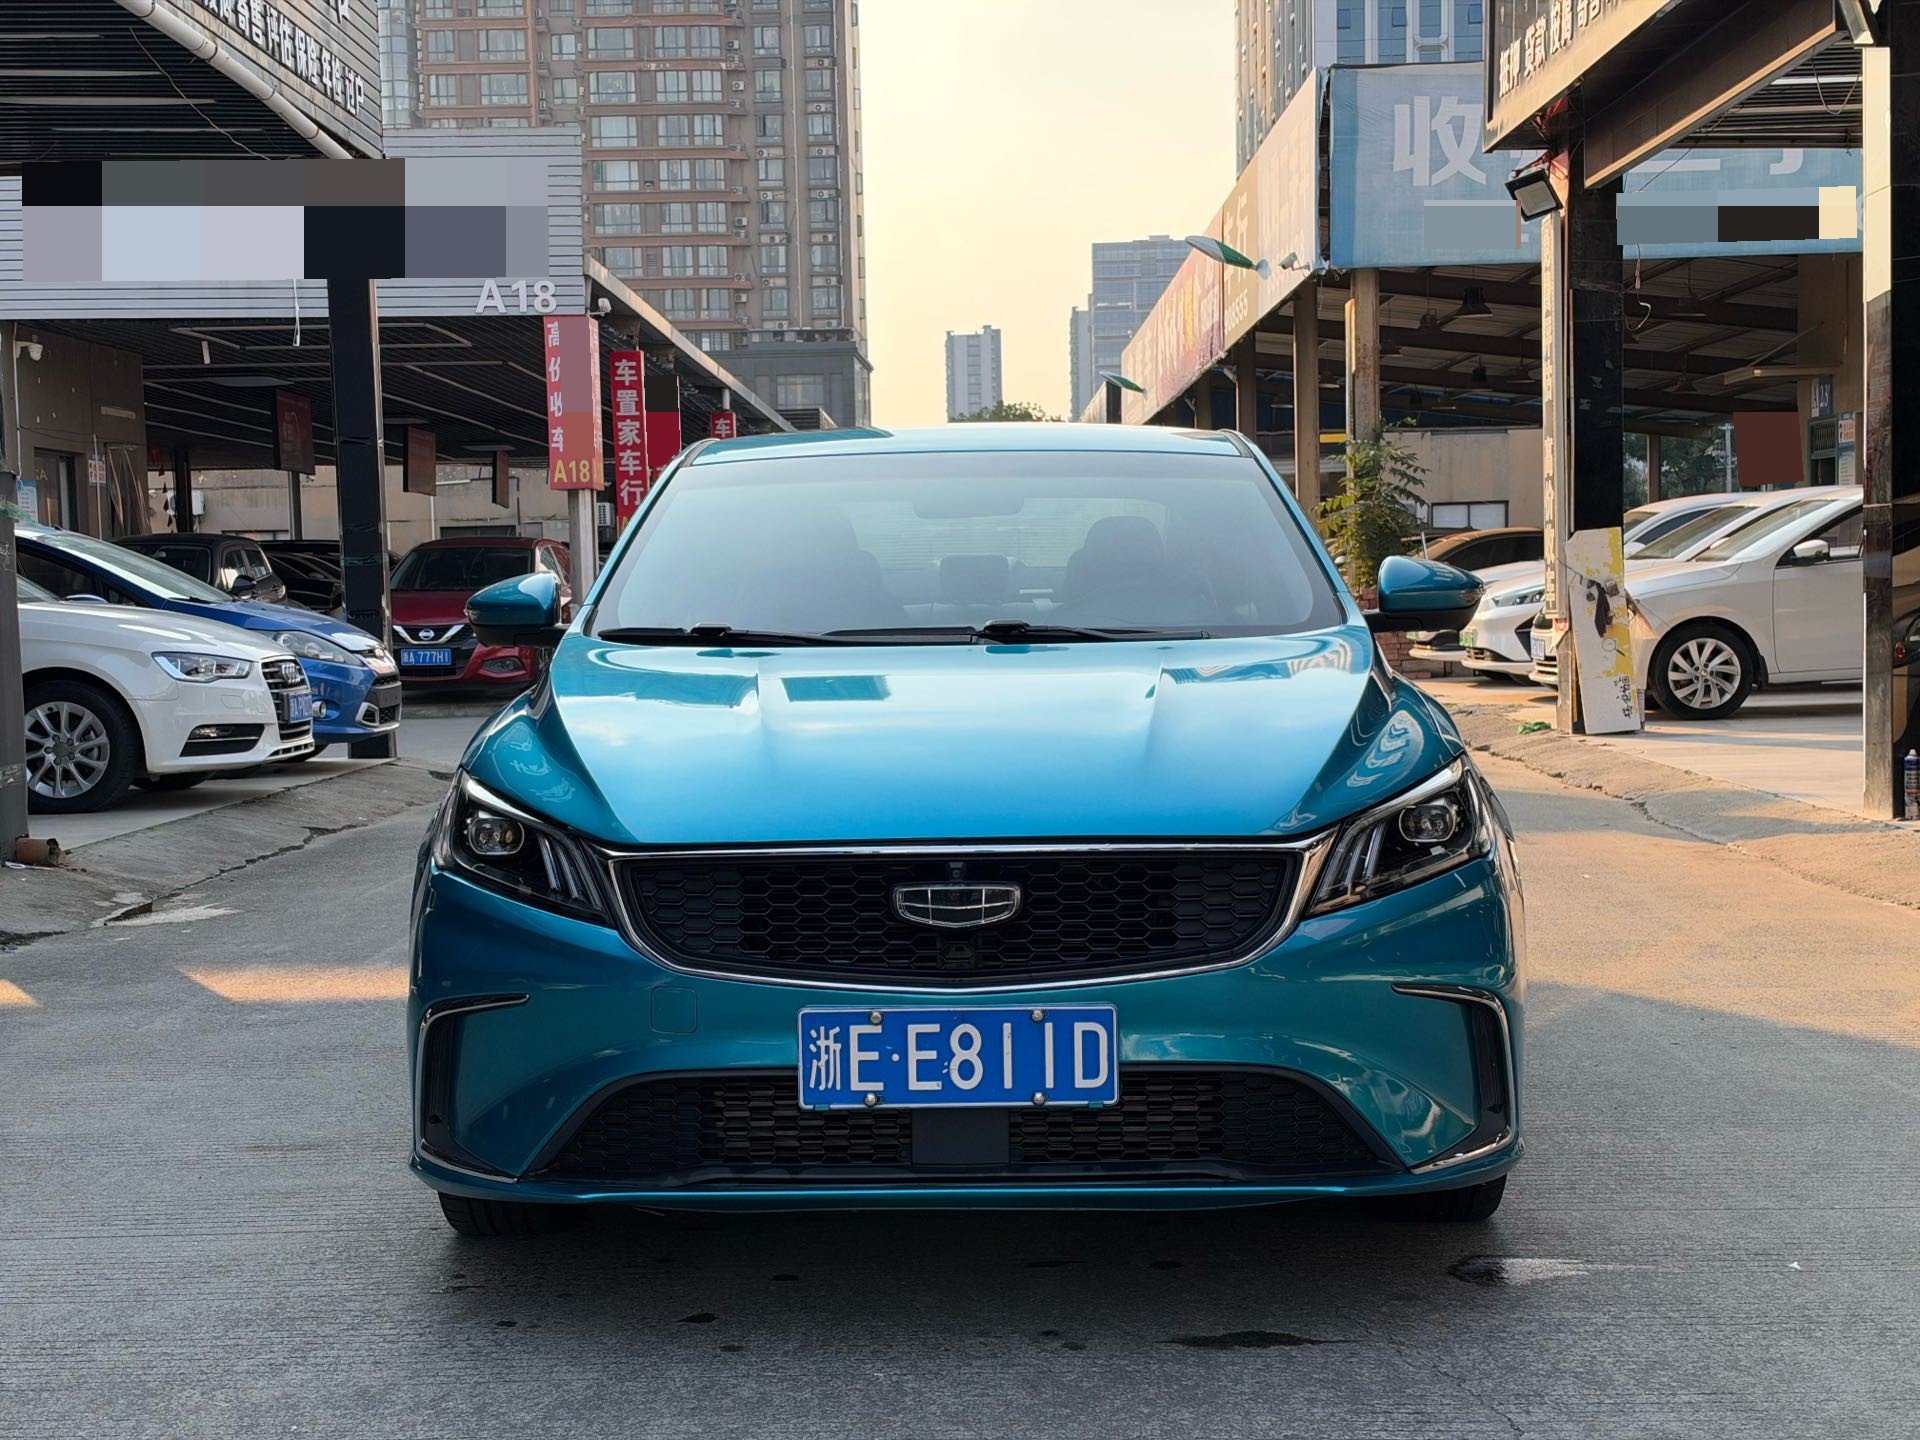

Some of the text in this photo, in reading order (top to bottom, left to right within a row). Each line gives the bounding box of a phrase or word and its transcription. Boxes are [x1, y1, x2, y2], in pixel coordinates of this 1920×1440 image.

[475, 279, 557, 313] A18
[614, 358, 645, 506] 车置家车行
[714, 418, 732, 438] 车
[553, 459, 591, 484] A18
